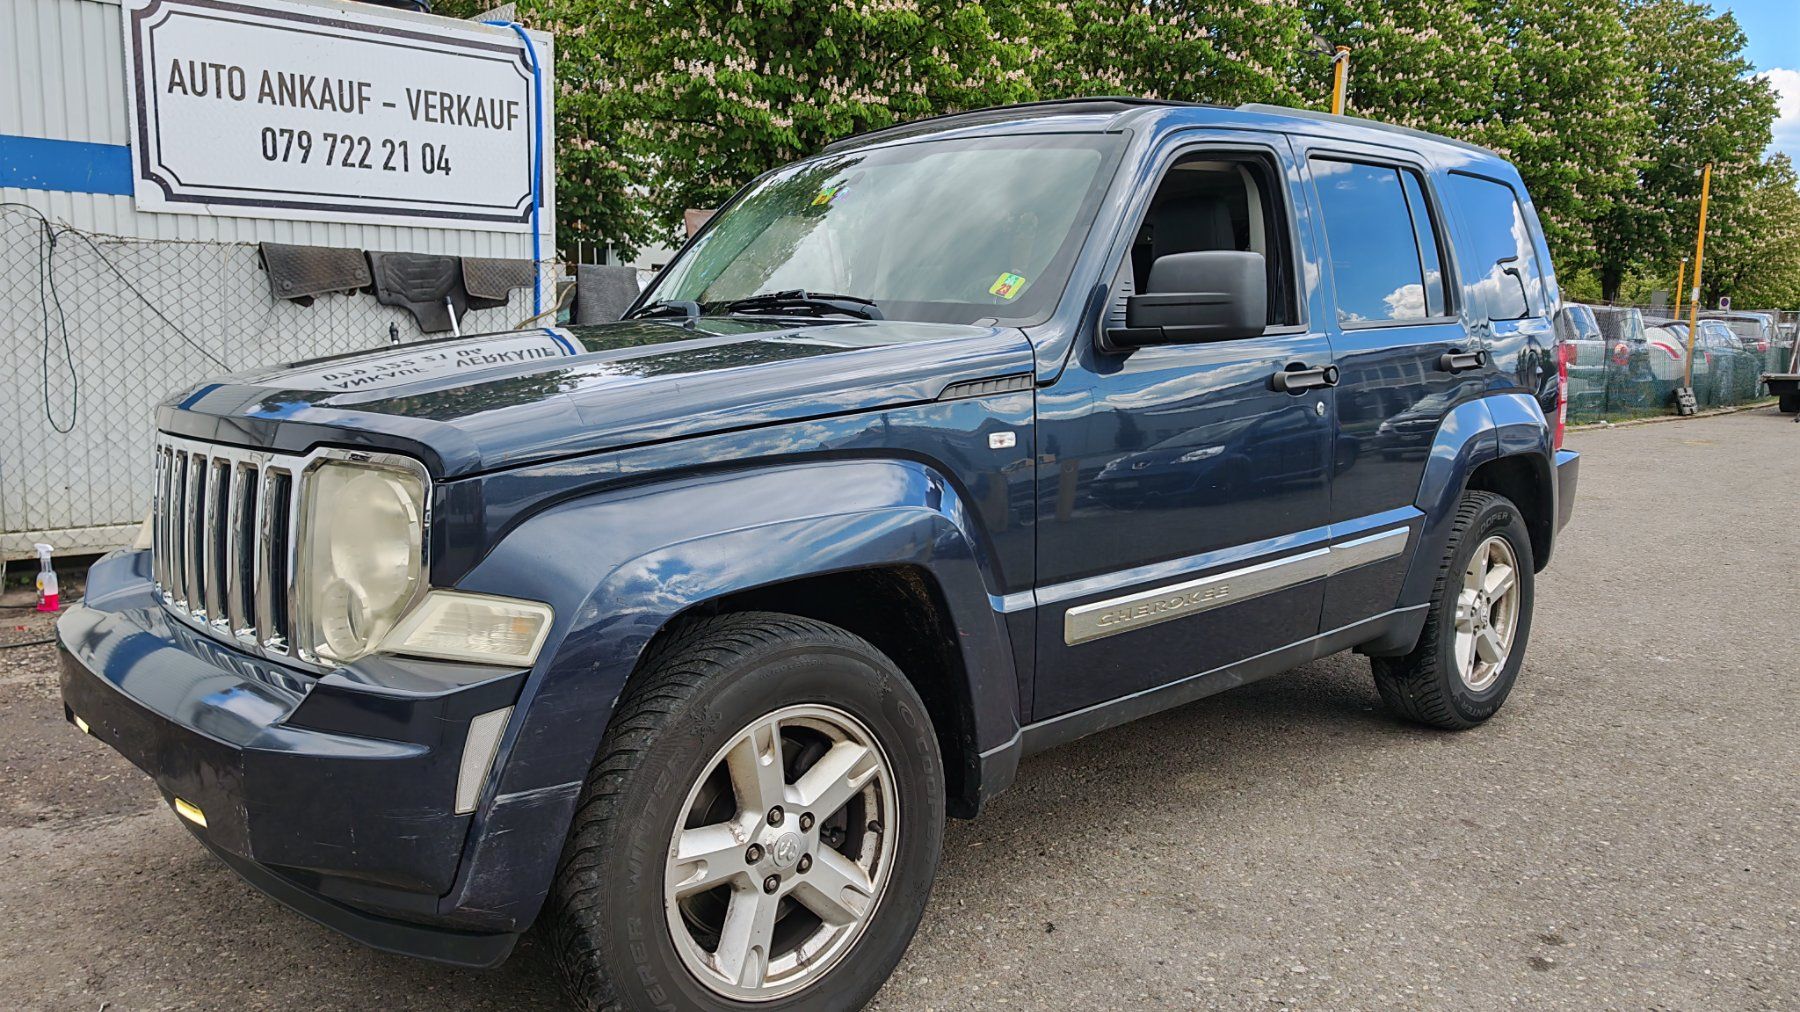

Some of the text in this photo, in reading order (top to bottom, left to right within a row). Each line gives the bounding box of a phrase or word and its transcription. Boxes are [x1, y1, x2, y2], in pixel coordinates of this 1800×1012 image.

[168, 59, 246, 102] AUTO
[257, 70, 372, 115] ANKAUF
[405, 88, 520, 131] VERKAUF
[261, 126, 452, 176] 079 722 21 04
[1096, 584, 1230, 627] CHEROKEE
